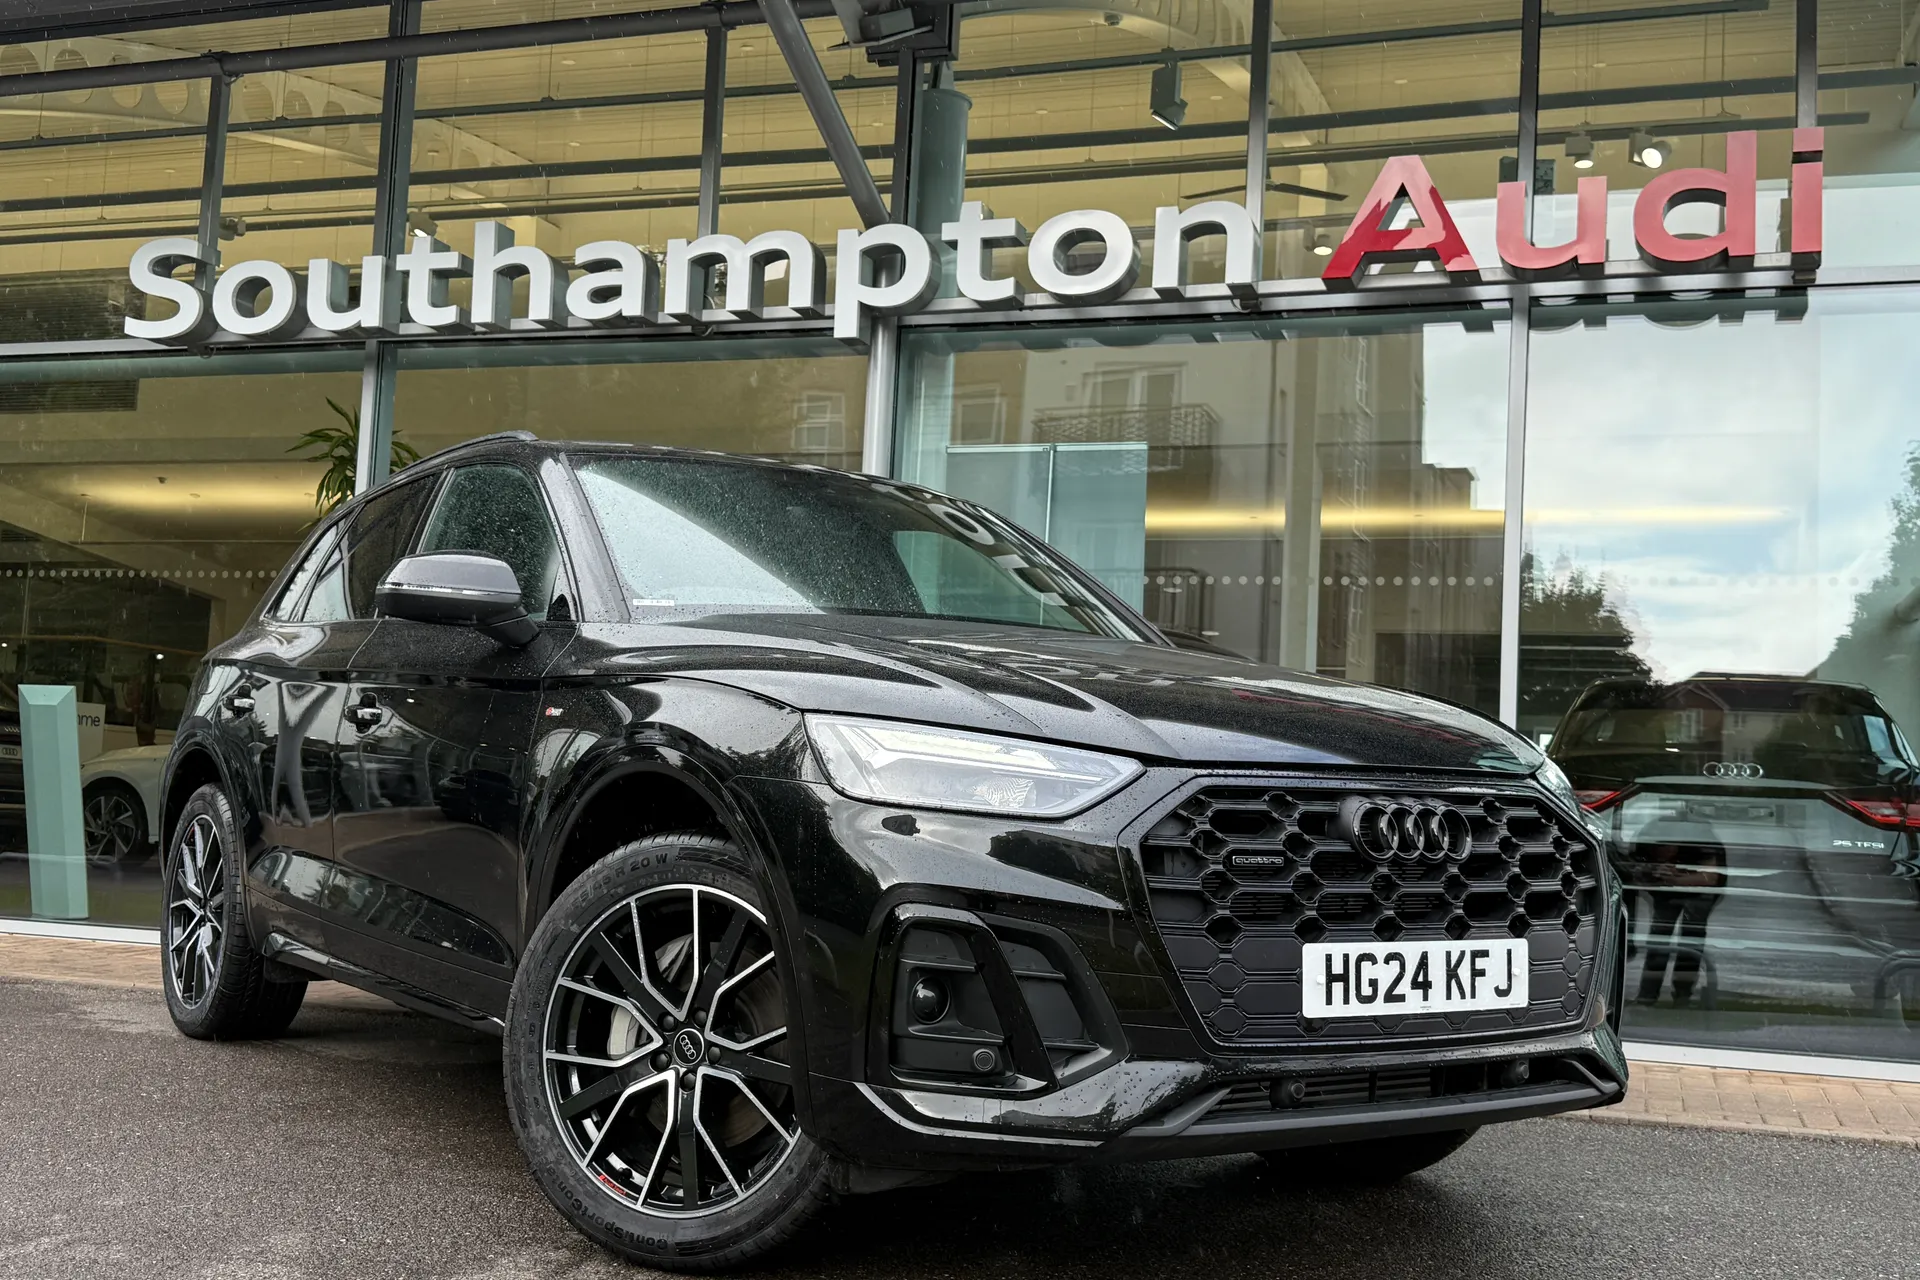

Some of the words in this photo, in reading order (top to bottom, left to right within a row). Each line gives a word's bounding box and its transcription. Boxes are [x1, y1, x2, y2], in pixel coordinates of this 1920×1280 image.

[123, 198, 1258, 340] Southampton
[1321, 126, 1825, 284] Audi
[1235, 857, 1283, 865] quattro
[1325, 950, 1433, 1006] HG24
[1445, 948, 1513, 1000] KFJ
